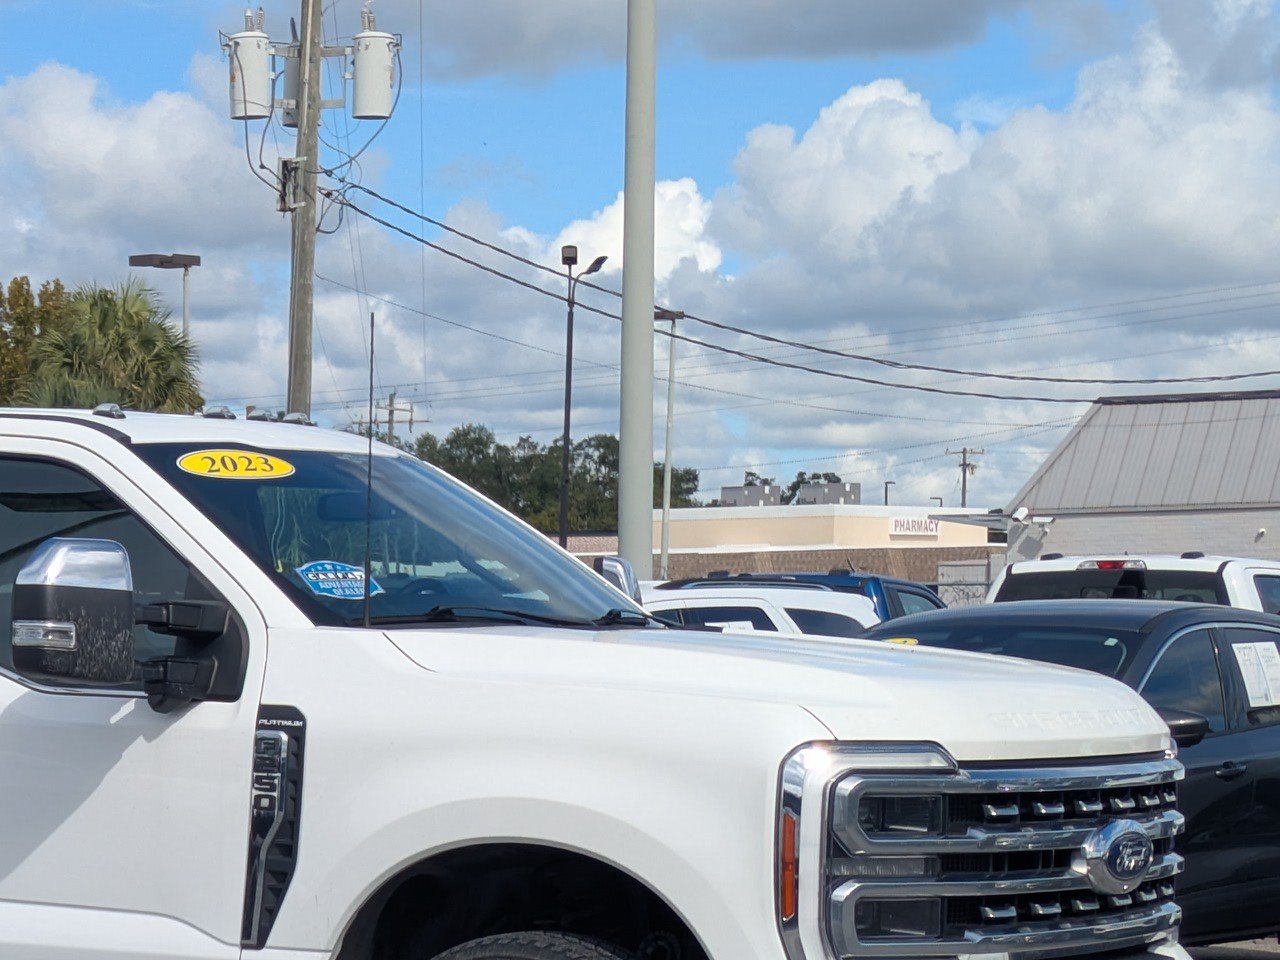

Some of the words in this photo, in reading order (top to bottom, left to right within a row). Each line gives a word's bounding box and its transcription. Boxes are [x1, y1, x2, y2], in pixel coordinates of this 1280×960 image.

[201, 455, 274, 473] 2023
[894, 519, 939, 533] PHARMACY
[259, 719, 303, 727] PLATINUM
